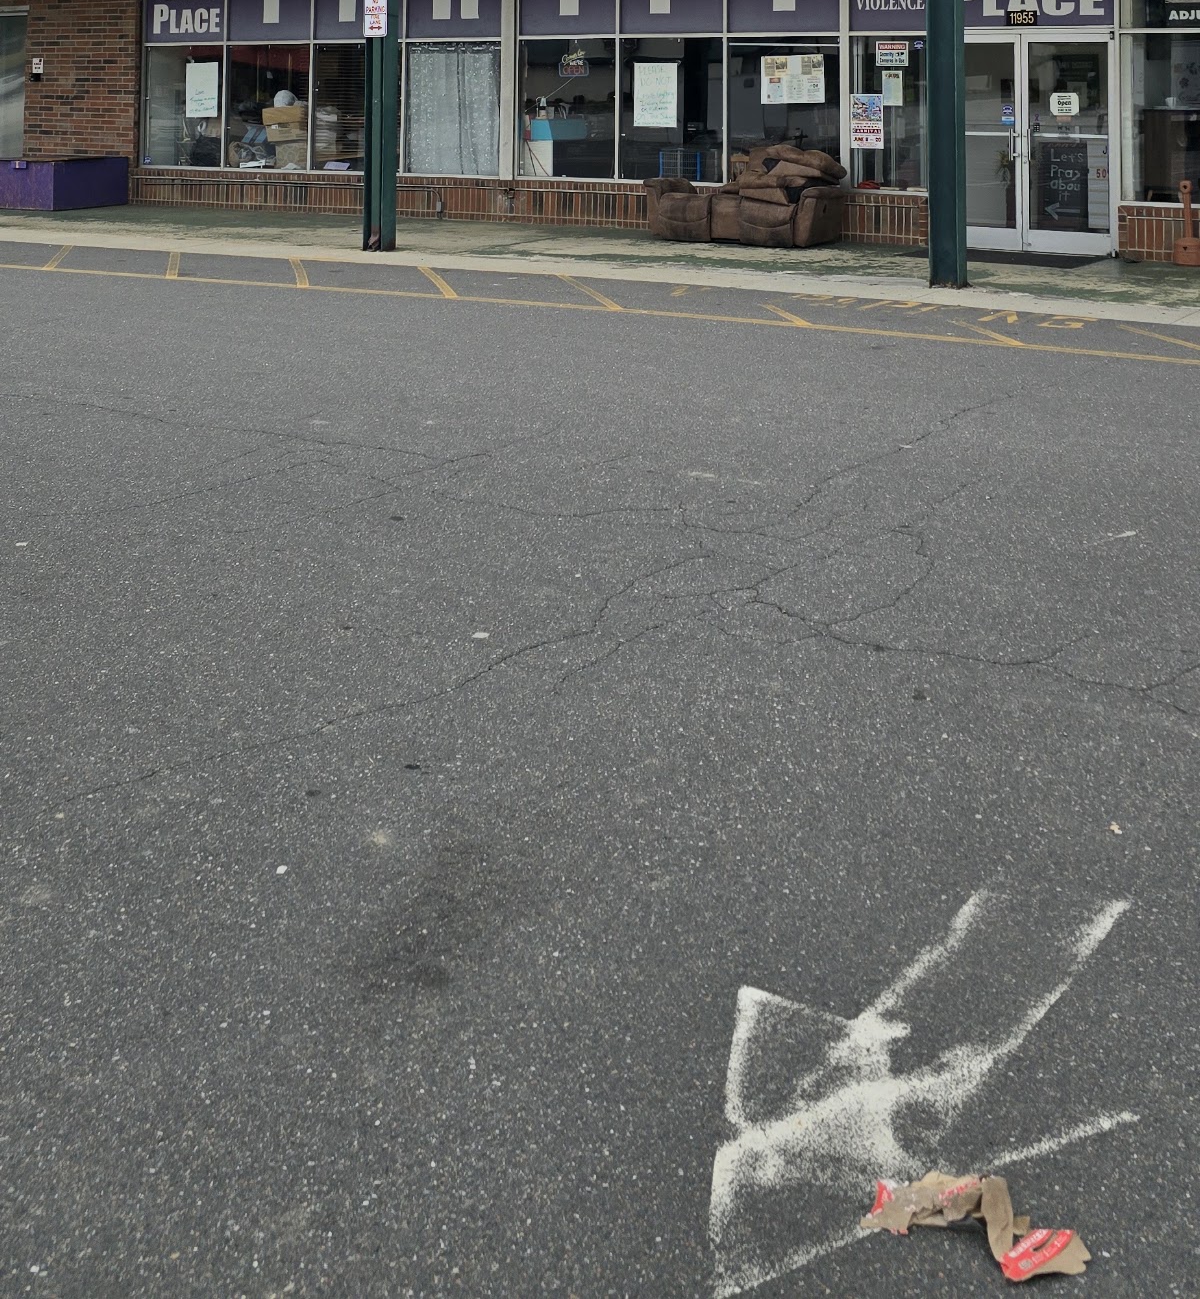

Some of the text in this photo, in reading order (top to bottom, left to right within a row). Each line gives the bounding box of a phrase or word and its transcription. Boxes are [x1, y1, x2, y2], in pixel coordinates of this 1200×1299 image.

[153, 3, 221, 34] PLACE
[1009, 12, 1034, 24] 11955
[563, 65, 585, 75] OPEN
